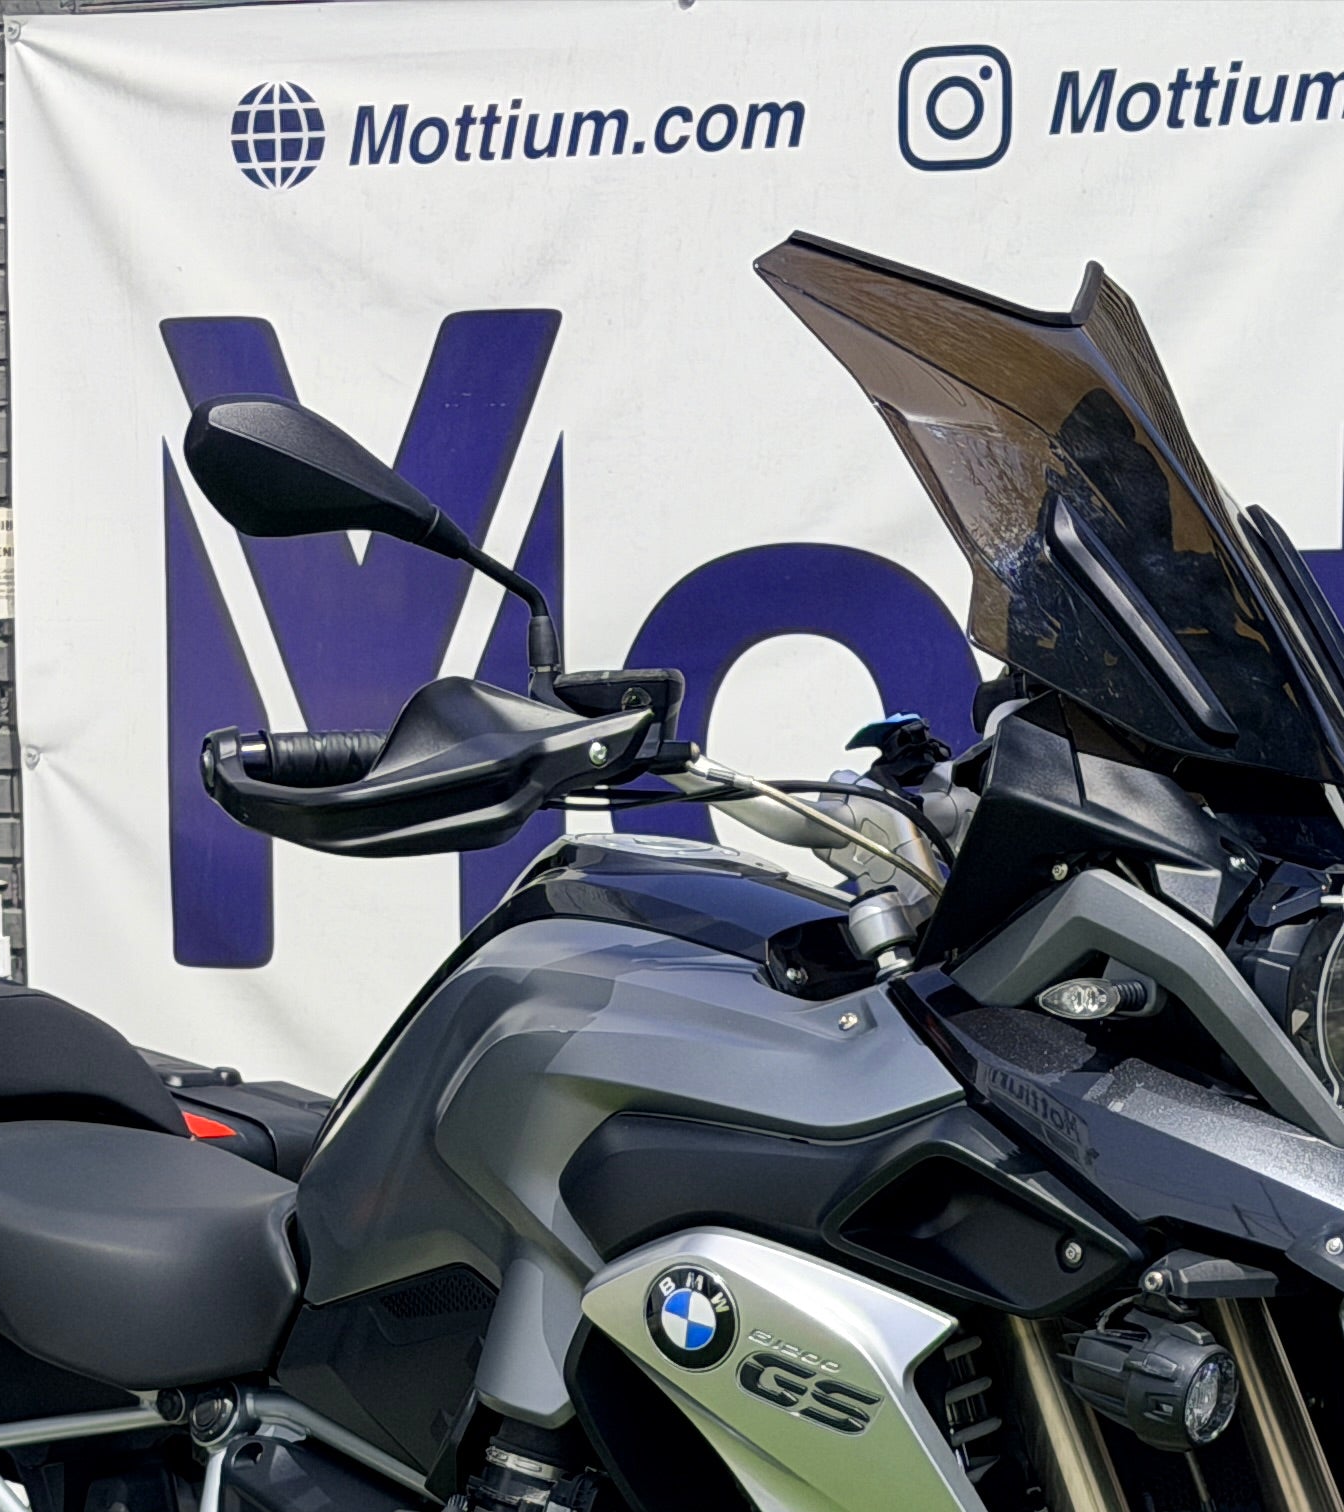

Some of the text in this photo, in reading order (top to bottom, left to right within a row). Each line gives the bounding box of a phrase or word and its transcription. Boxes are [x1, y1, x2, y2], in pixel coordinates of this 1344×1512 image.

[348, 97, 806, 166] Mottium.com
[659, 1271, 730, 1313] BMW
[736, 1351, 884, 1436] GS
